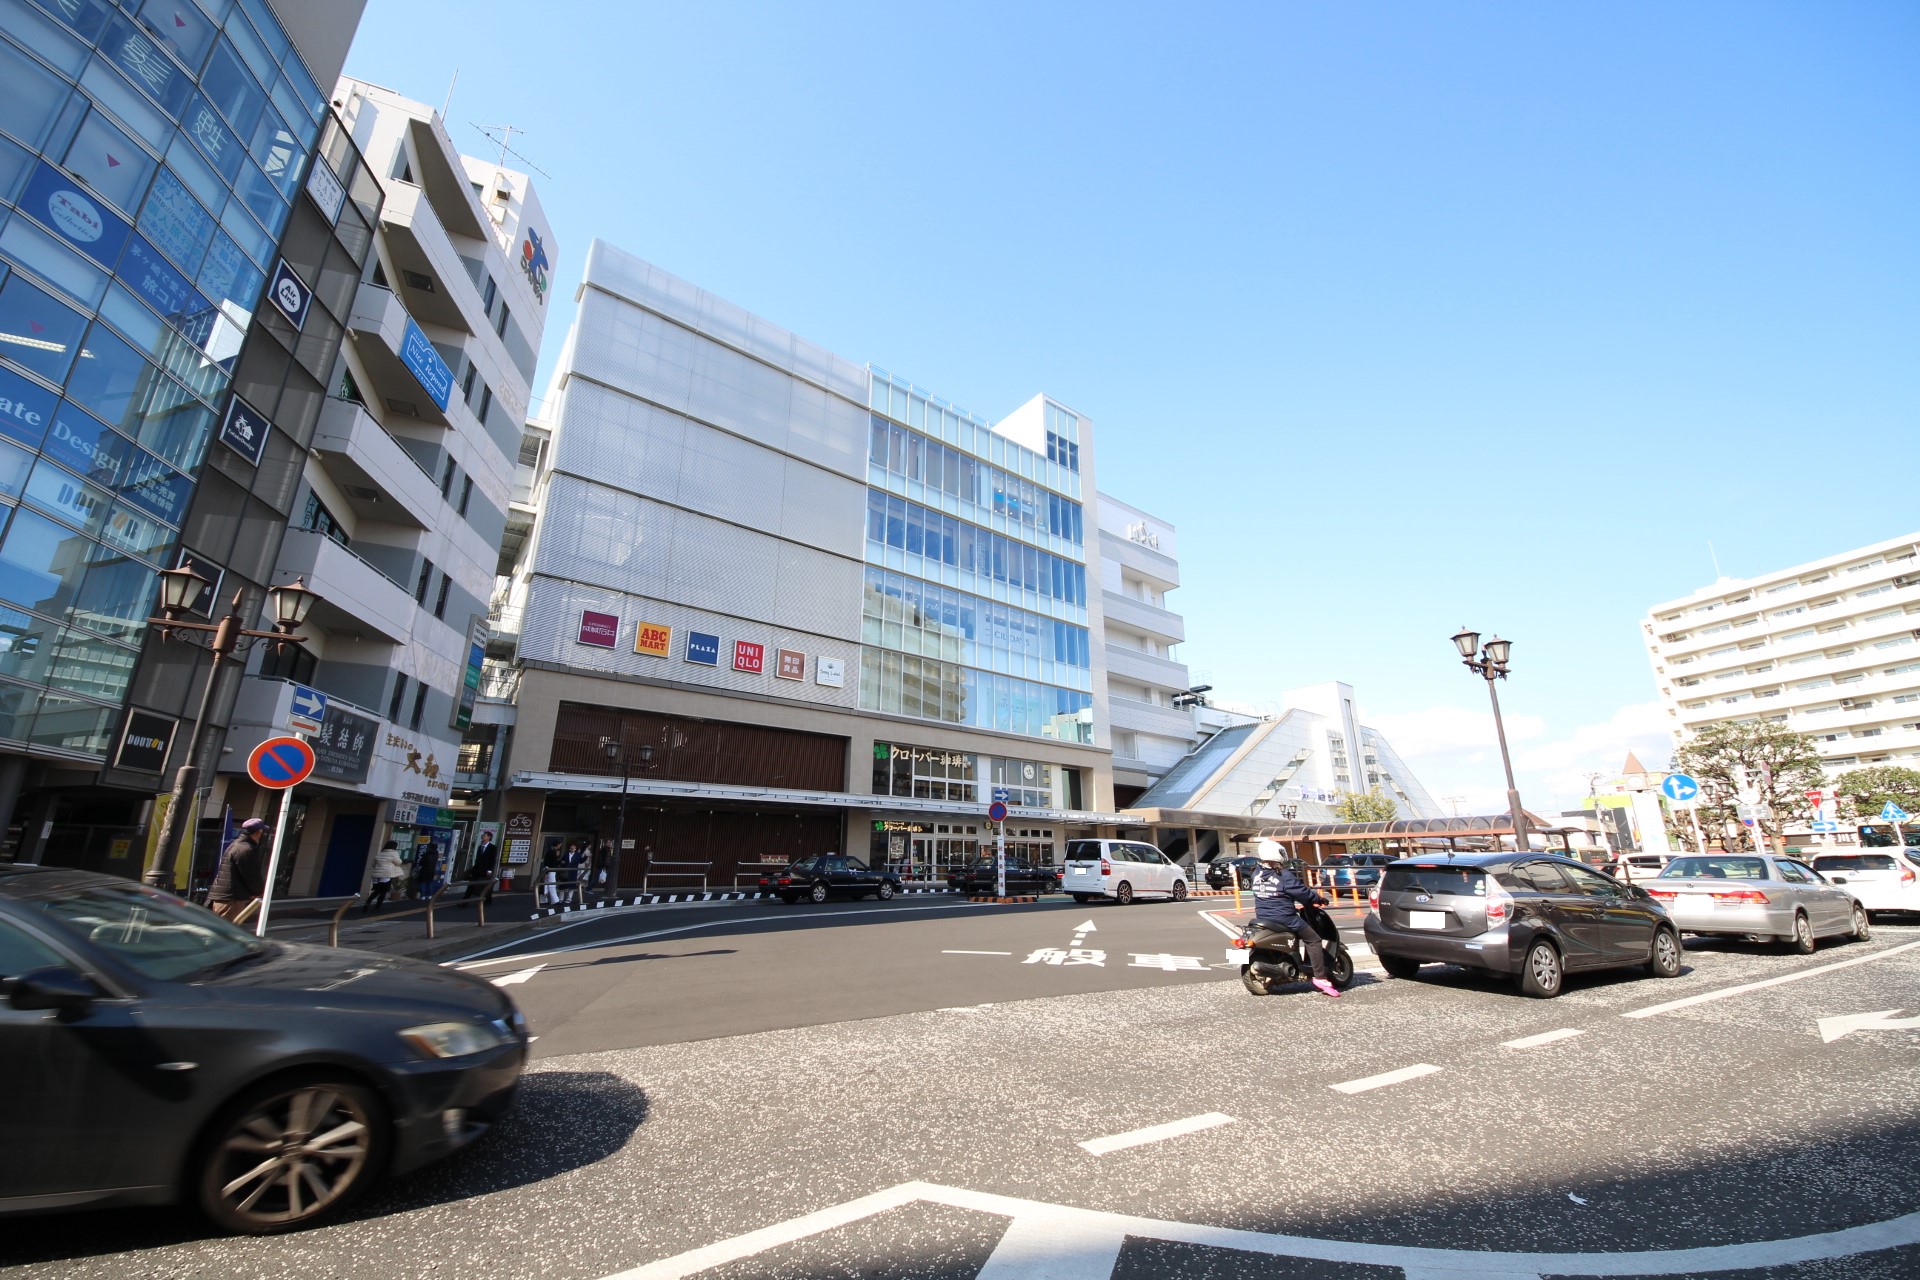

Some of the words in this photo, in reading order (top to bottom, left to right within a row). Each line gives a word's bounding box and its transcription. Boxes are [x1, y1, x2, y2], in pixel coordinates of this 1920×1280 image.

[57, 194, 99, 230] Tabi
[280, 287, 297, 308] Link
[284, 284, 297, 298] Air
[410, 345, 424, 365] Nice
[52, 420, 122, 474] Design
[641, 628, 667, 642] ABC
[640, 639, 666, 651] MART
[690, 643, 716, 654] PLAZA
[739, 644, 759, 657] UNI
[737, 656, 760, 669] QLO
[784, 655, 800, 665] 無印
[783, 664, 799, 674] 良品
[127, 734, 164, 751] DOUTOR
[320, 722, 364, 756] 髪結師
[386, 732, 414, 751] 住まいの
